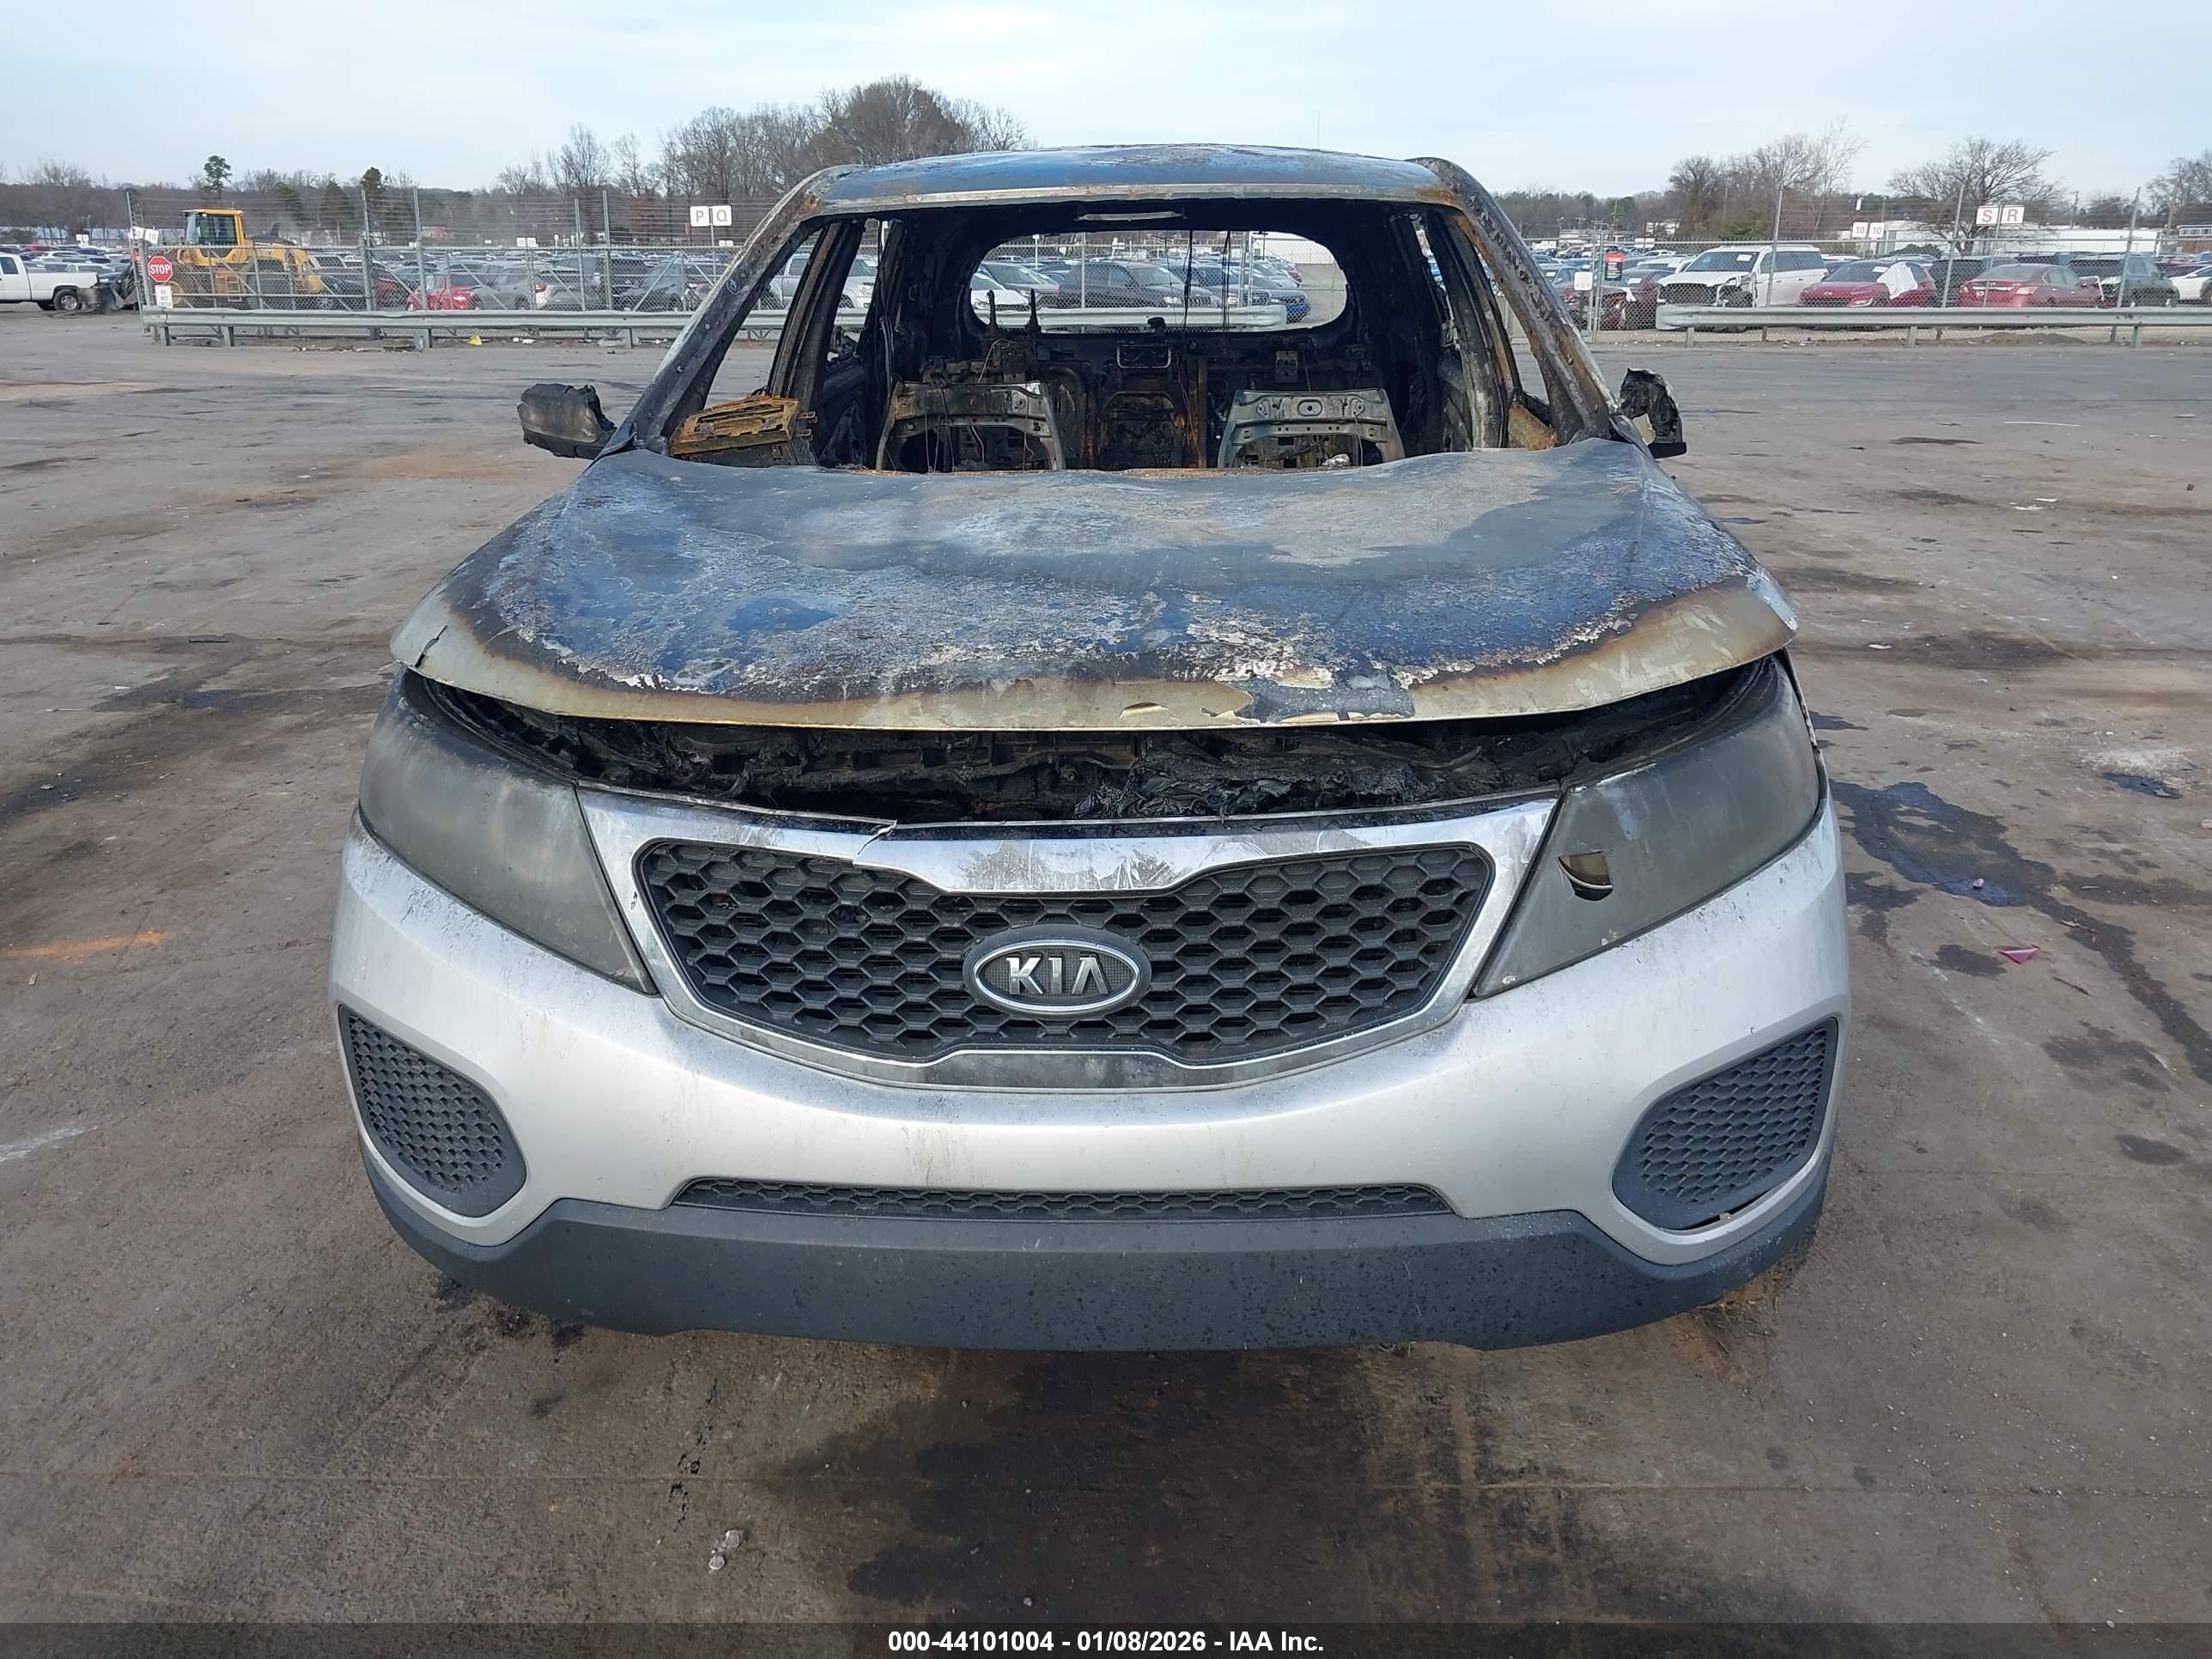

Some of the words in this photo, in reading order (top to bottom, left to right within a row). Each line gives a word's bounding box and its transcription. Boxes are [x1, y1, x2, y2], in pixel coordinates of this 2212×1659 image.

[696, 210, 704, 222] P
[716, 210, 728, 222] Q
[1981, 209, 1992, 222] S
[2007, 209, 2018, 222] R
[1856, 226, 1865, 234] 10
[1872, 226, 1882, 234] 10
[150, 264, 170, 275] STOP
[1006, 957, 1109, 995] KIA
